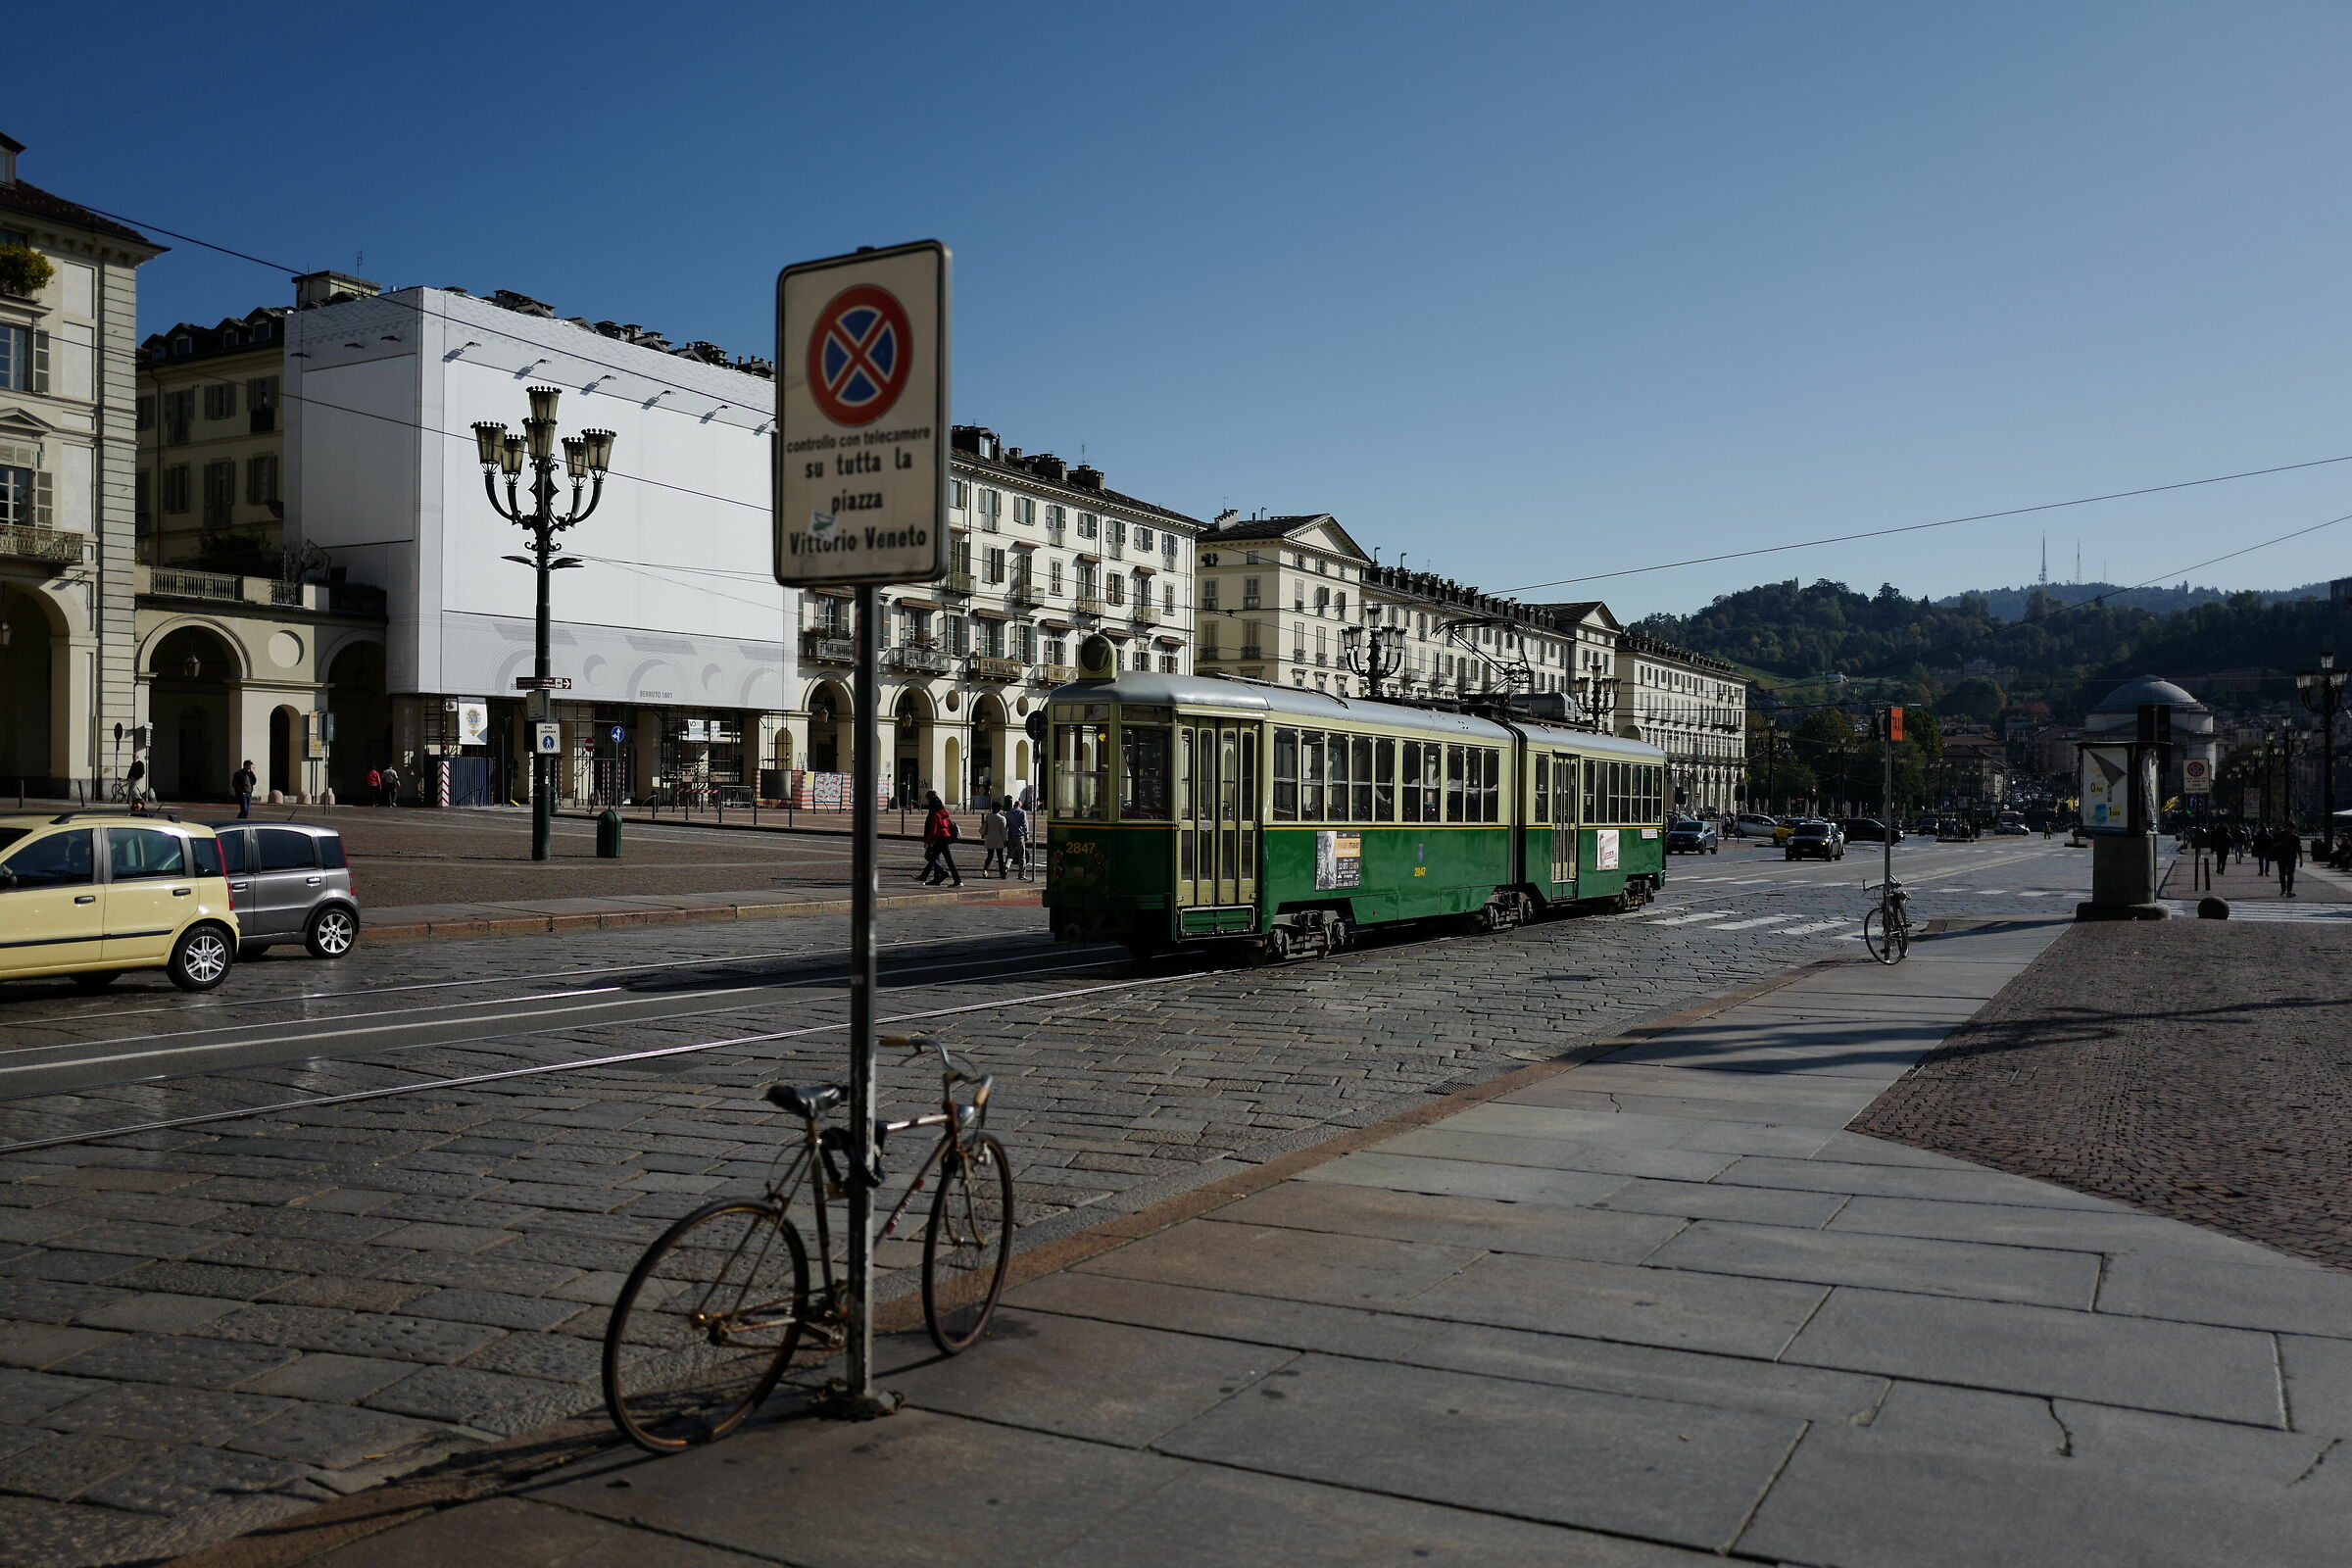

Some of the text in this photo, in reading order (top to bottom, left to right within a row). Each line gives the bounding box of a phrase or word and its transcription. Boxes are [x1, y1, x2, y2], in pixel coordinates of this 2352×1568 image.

[786, 426, 930, 453] controllo con telecamere
[805, 446, 912, 478] su tutta la
[831, 490, 883, 514] piazza
[864, 524, 927, 550] Veneto
[1066, 841, 1097, 855] 2847
[1414, 866, 1427, 877] 2847
